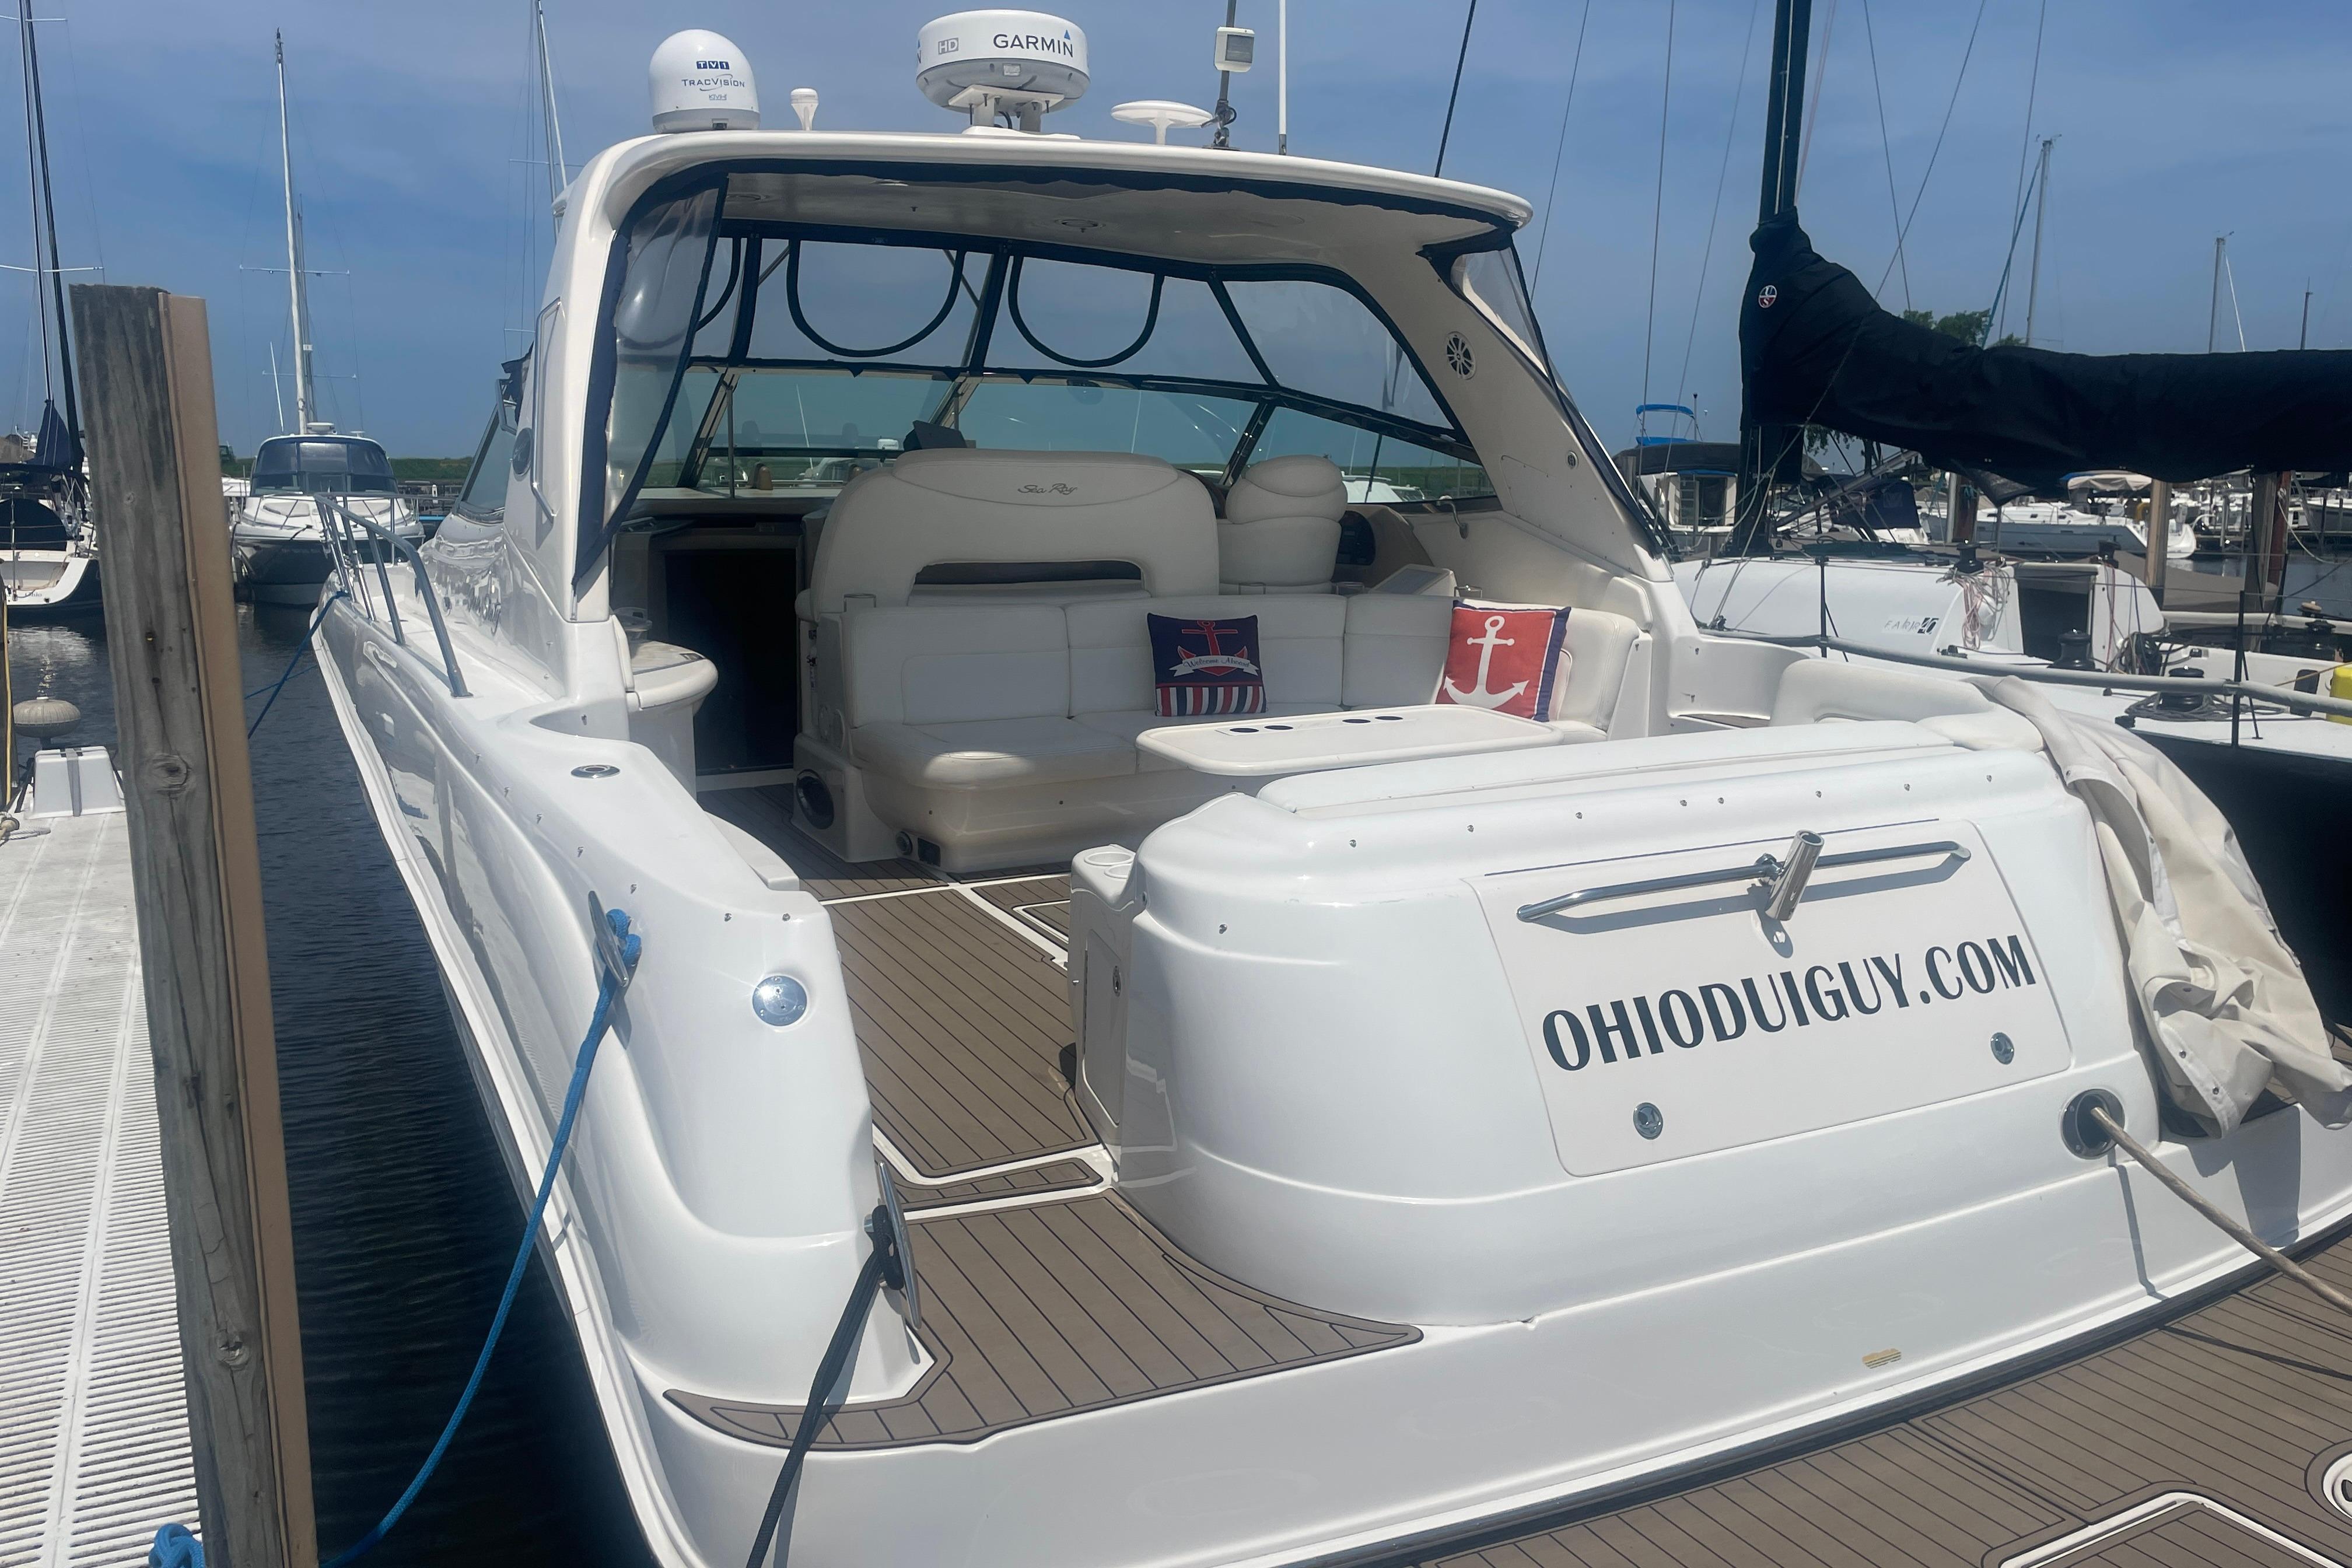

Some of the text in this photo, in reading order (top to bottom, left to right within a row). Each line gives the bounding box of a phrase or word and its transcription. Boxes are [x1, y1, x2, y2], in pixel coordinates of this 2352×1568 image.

[939, 39, 958, 54] HD
[993, 33, 1073, 58] GARMIN
[698, 61, 728, 69] TV1
[1017, 482, 1078, 495] Sea Ray
[1183, 656, 1250, 668] Welcome Aboard
[1542, 935, 2036, 1072] OHIODUIGUY.COM
